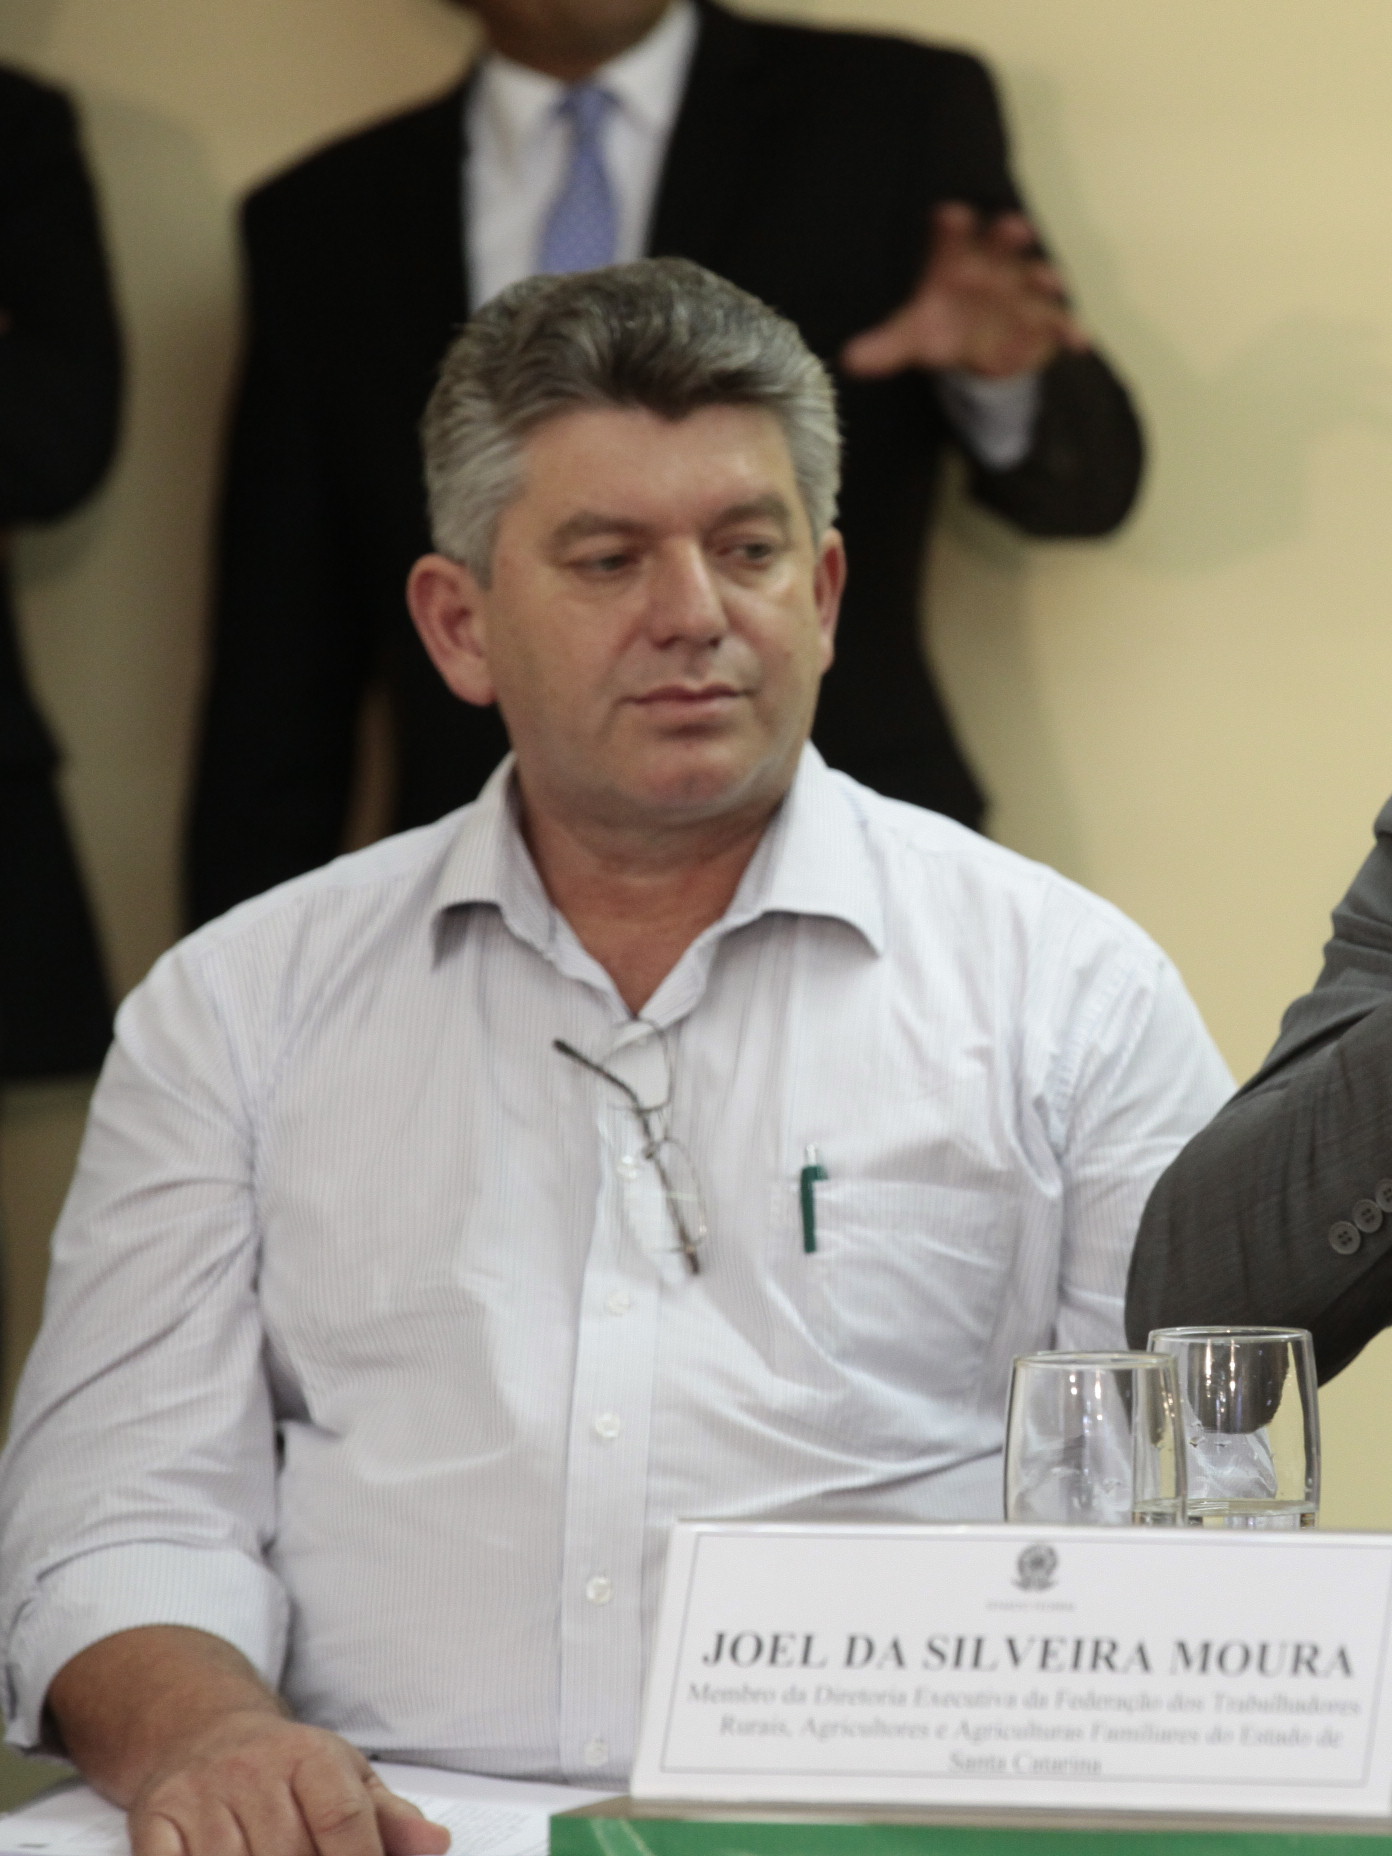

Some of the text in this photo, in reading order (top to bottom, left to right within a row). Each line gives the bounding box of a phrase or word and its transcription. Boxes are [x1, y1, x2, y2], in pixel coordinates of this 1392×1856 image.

[701, 1629, 1355, 1679] JOEL DA SILVEIRA MOURA
[687, 1682, 1362, 1717] Membro da Diretoria Executiva da Federação dos Trabalhadores
[800, 1716, 928, 1743] Agricultores
[934, 1721, 948, 1739] e
[1089, 1720, 1199, 1745] Familiares
[1240, 1723, 1312, 1747] Estado
[948, 1749, 1103, 1775] Santa Catarina
